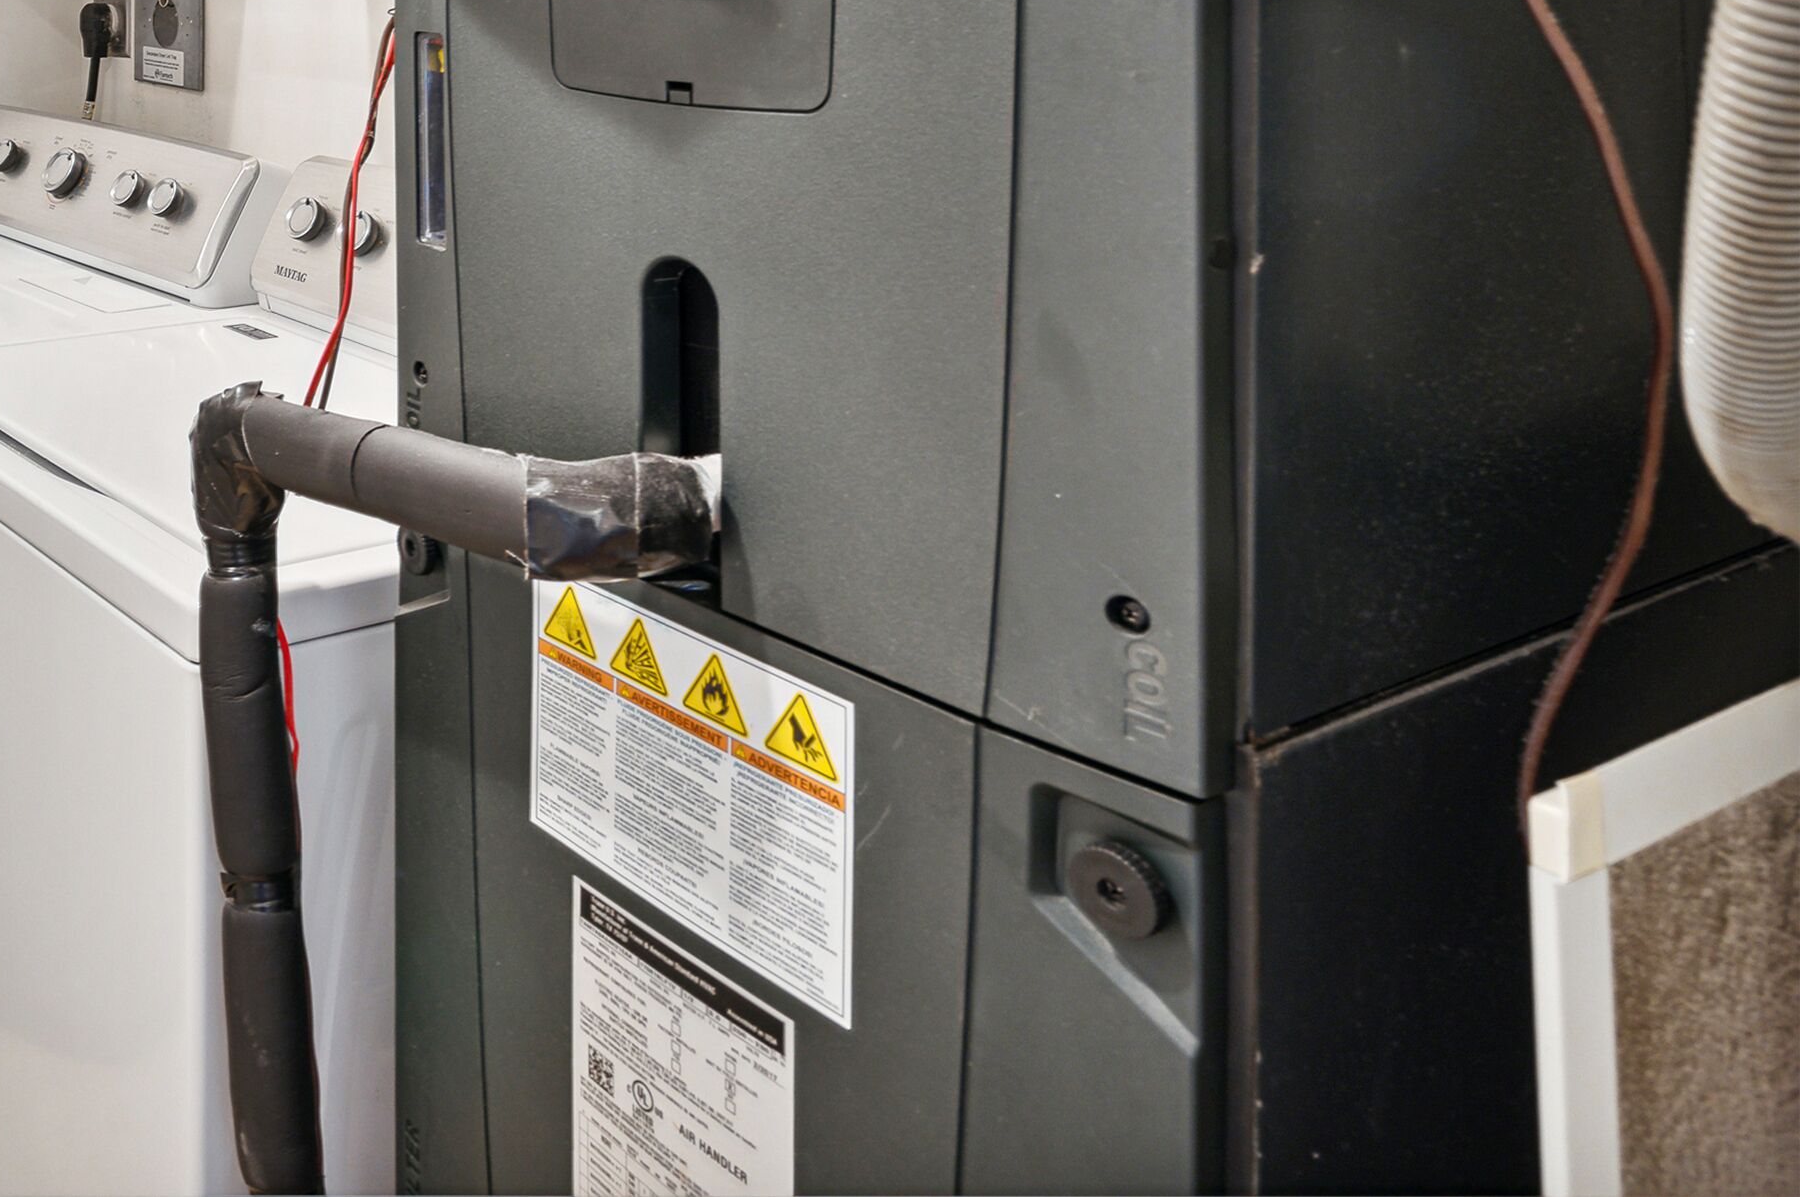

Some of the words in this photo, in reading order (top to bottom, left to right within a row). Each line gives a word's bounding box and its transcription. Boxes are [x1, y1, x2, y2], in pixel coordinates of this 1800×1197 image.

[274, 265, 308, 282] MAYTAG
[406, 388, 421, 430] OIL
[557, 651, 601, 682] WARNING
[1123, 639, 1173, 743] COIL
[632, 690, 721, 746] AVERTISSEMENT
[748, 750, 840, 807] ADVERTENCIA
[678, 1124, 696, 1144] AIR
[699, 1139, 748, 1184] HANDLER
